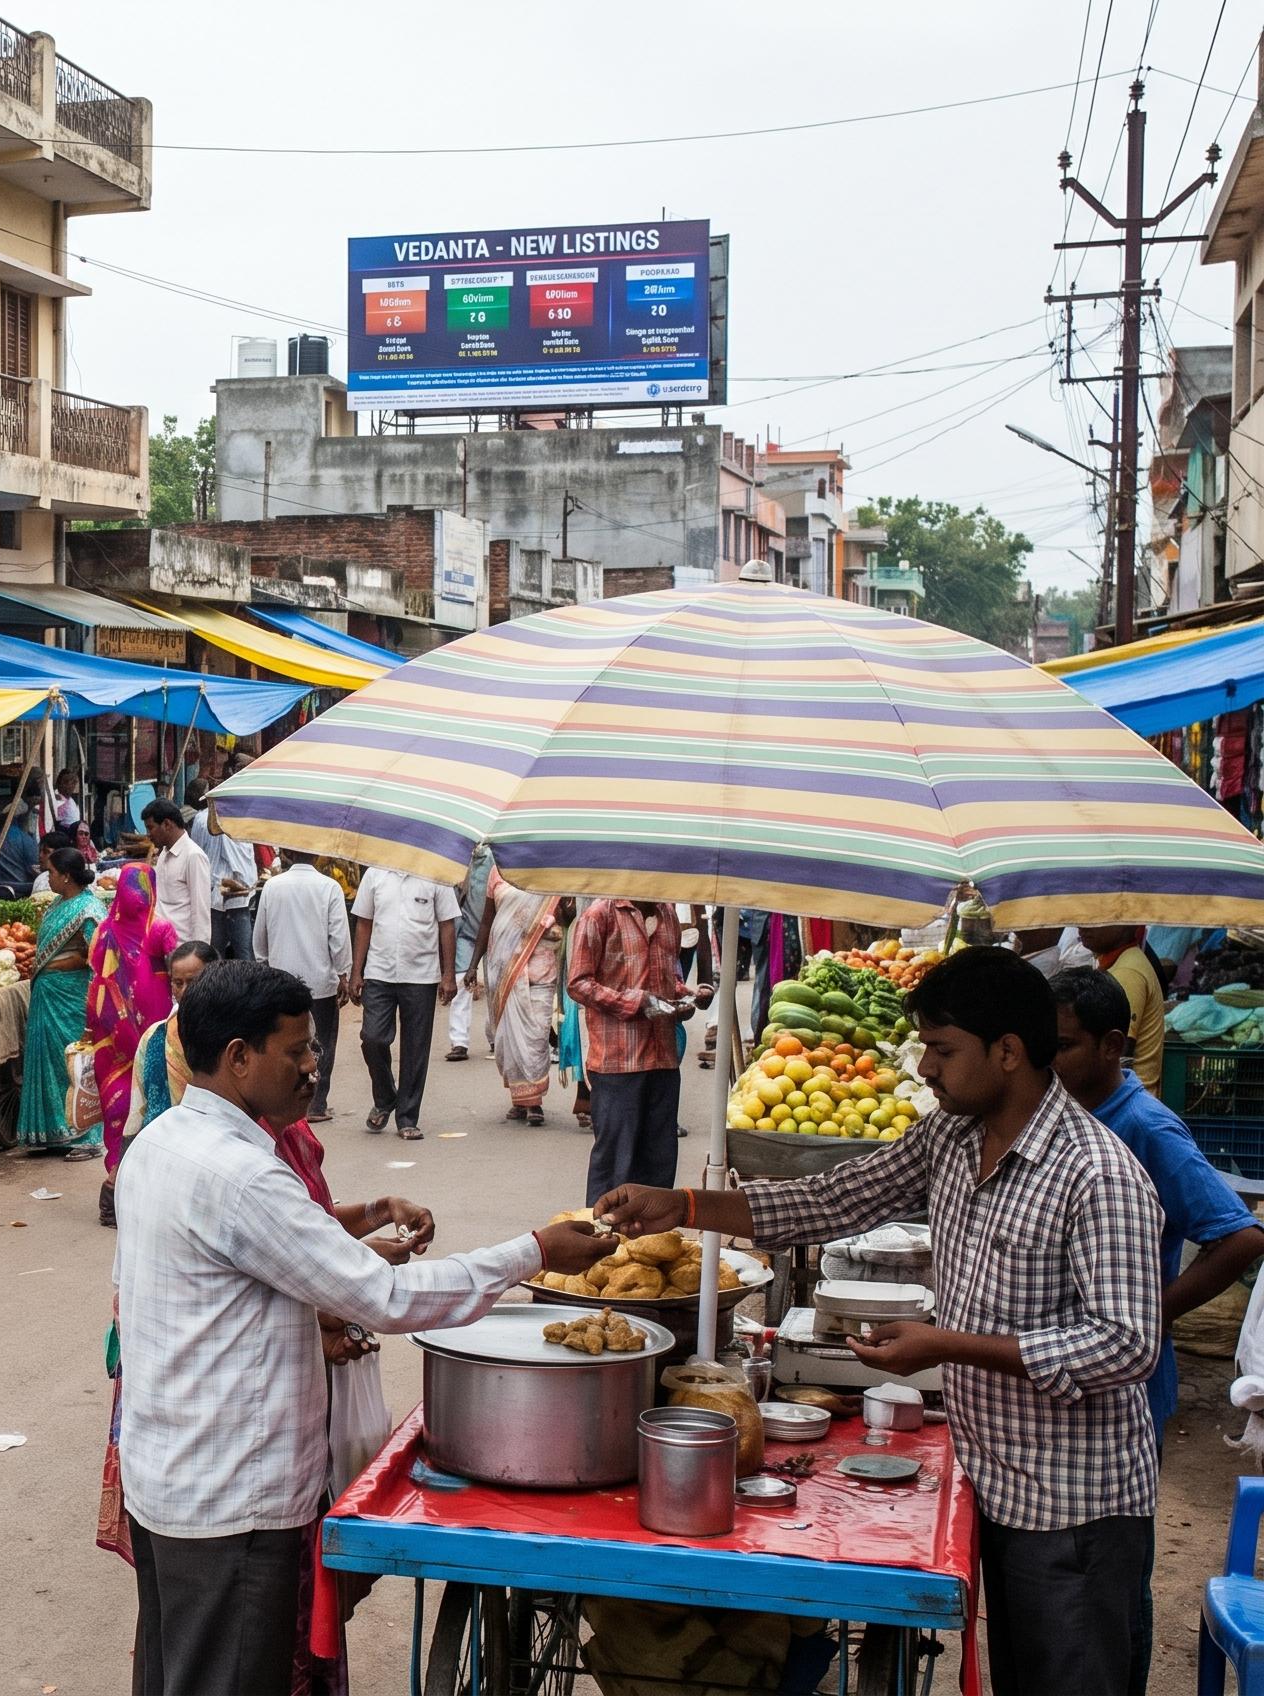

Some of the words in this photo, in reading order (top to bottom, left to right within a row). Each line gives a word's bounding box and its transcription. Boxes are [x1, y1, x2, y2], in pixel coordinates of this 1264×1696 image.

[394, 238, 490, 262] VEDANTA
[510, 234, 557, 257] NEW
[563, 229, 660, 255] LISTINGS
